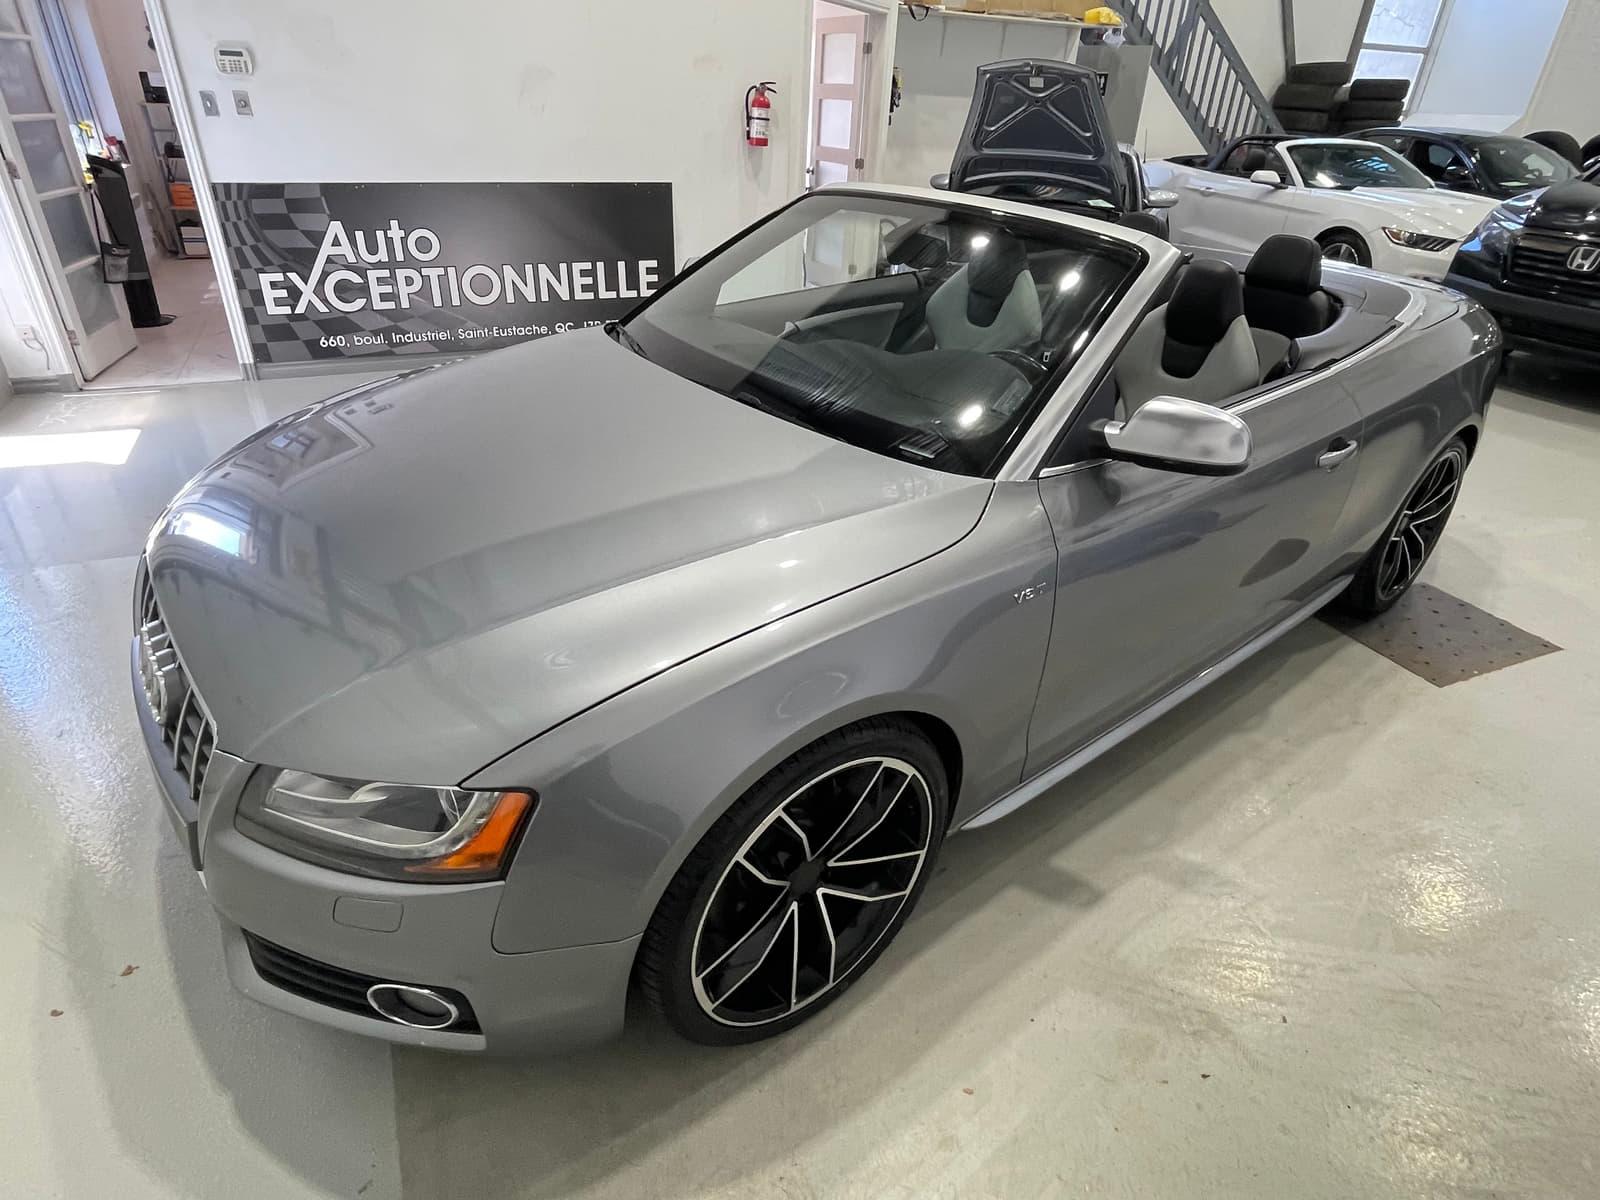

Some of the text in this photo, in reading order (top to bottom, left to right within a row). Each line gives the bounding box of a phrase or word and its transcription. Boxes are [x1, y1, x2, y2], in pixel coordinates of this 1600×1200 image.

[317, 218, 441, 264] Auto
[258, 259, 659, 316] EXCEPTIONNELLE
[319, 335, 351, 348] 660,
[353, 333, 388, 346] boul.
[391, 329, 455, 344] Industriel,
